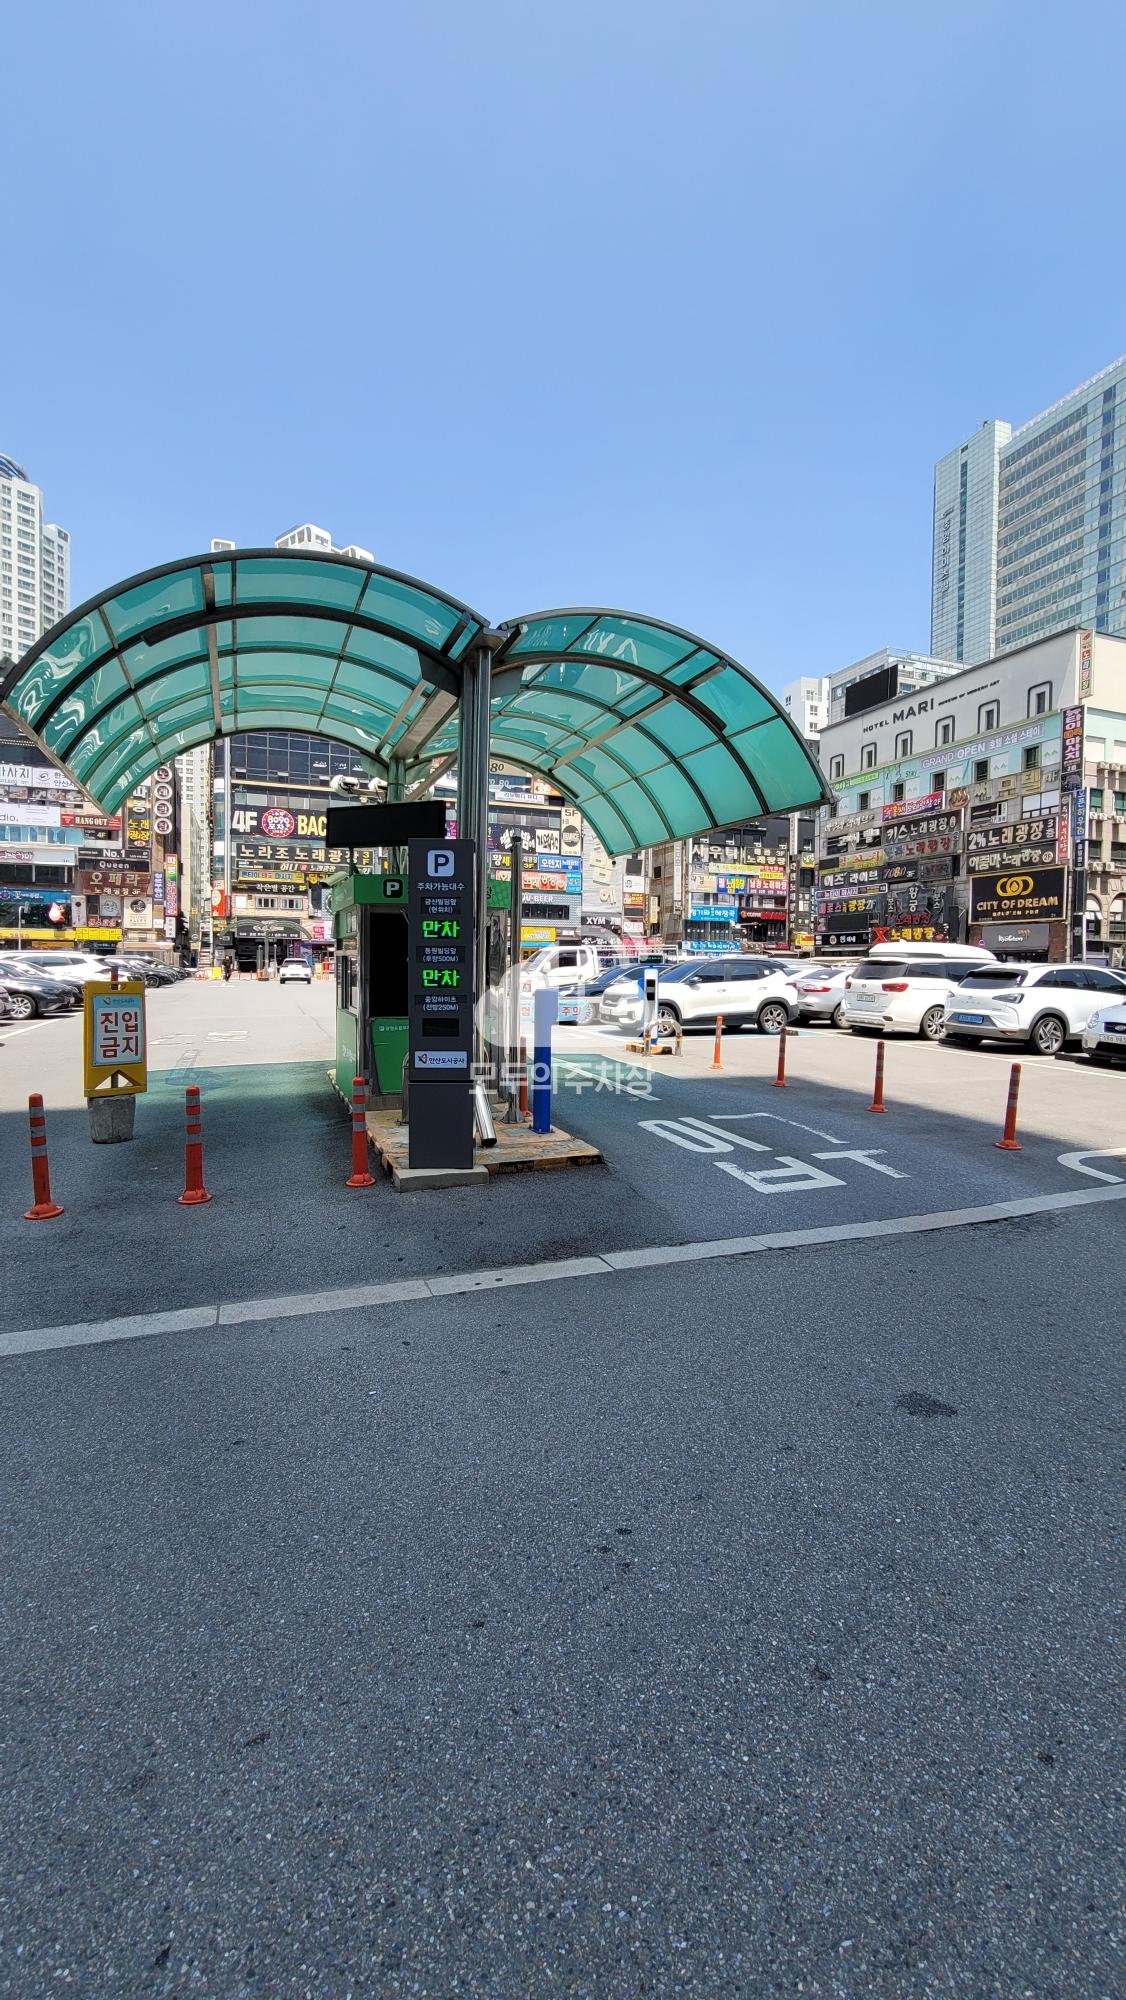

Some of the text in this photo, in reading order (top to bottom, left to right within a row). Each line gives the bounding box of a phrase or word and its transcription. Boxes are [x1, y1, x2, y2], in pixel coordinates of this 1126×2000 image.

[863, 721, 890, 733] HOTEL
[893, 698, 934, 724] MARI
[922, 752, 954, 769] GRAND
[957, 743, 986, 758] OPEN
[75, 816, 94, 825] HANG
[94, 818, 107, 826] OUT
[232, 810, 258, 833] 4F
[887, 816, 948, 840] 키스 노래광장
[969, 819, 1056, 850] 2% 노래광장 3층
[103, 849, 126, 859] No.1
[240, 844, 289, 859] 노라조
[99, 861, 130, 870] Queen
[541, 859, 562, 868] 오렌지
[89, 872, 140, 886] 오페라
[850, 870, 878, 884] 라이브
[416, 882, 465, 892] 주차가능대수
[976, 896, 1058, 911] CITY OF DREAM
[422, 921, 460, 938] 만차
[871, 927, 890, 944] X
[422, 969, 460, 987] 만차
[100, 1011, 139, 1034] 진입
[99, 1035, 139, 1058] 금지
[428, 1056, 465, 1065] 안산도시공사
